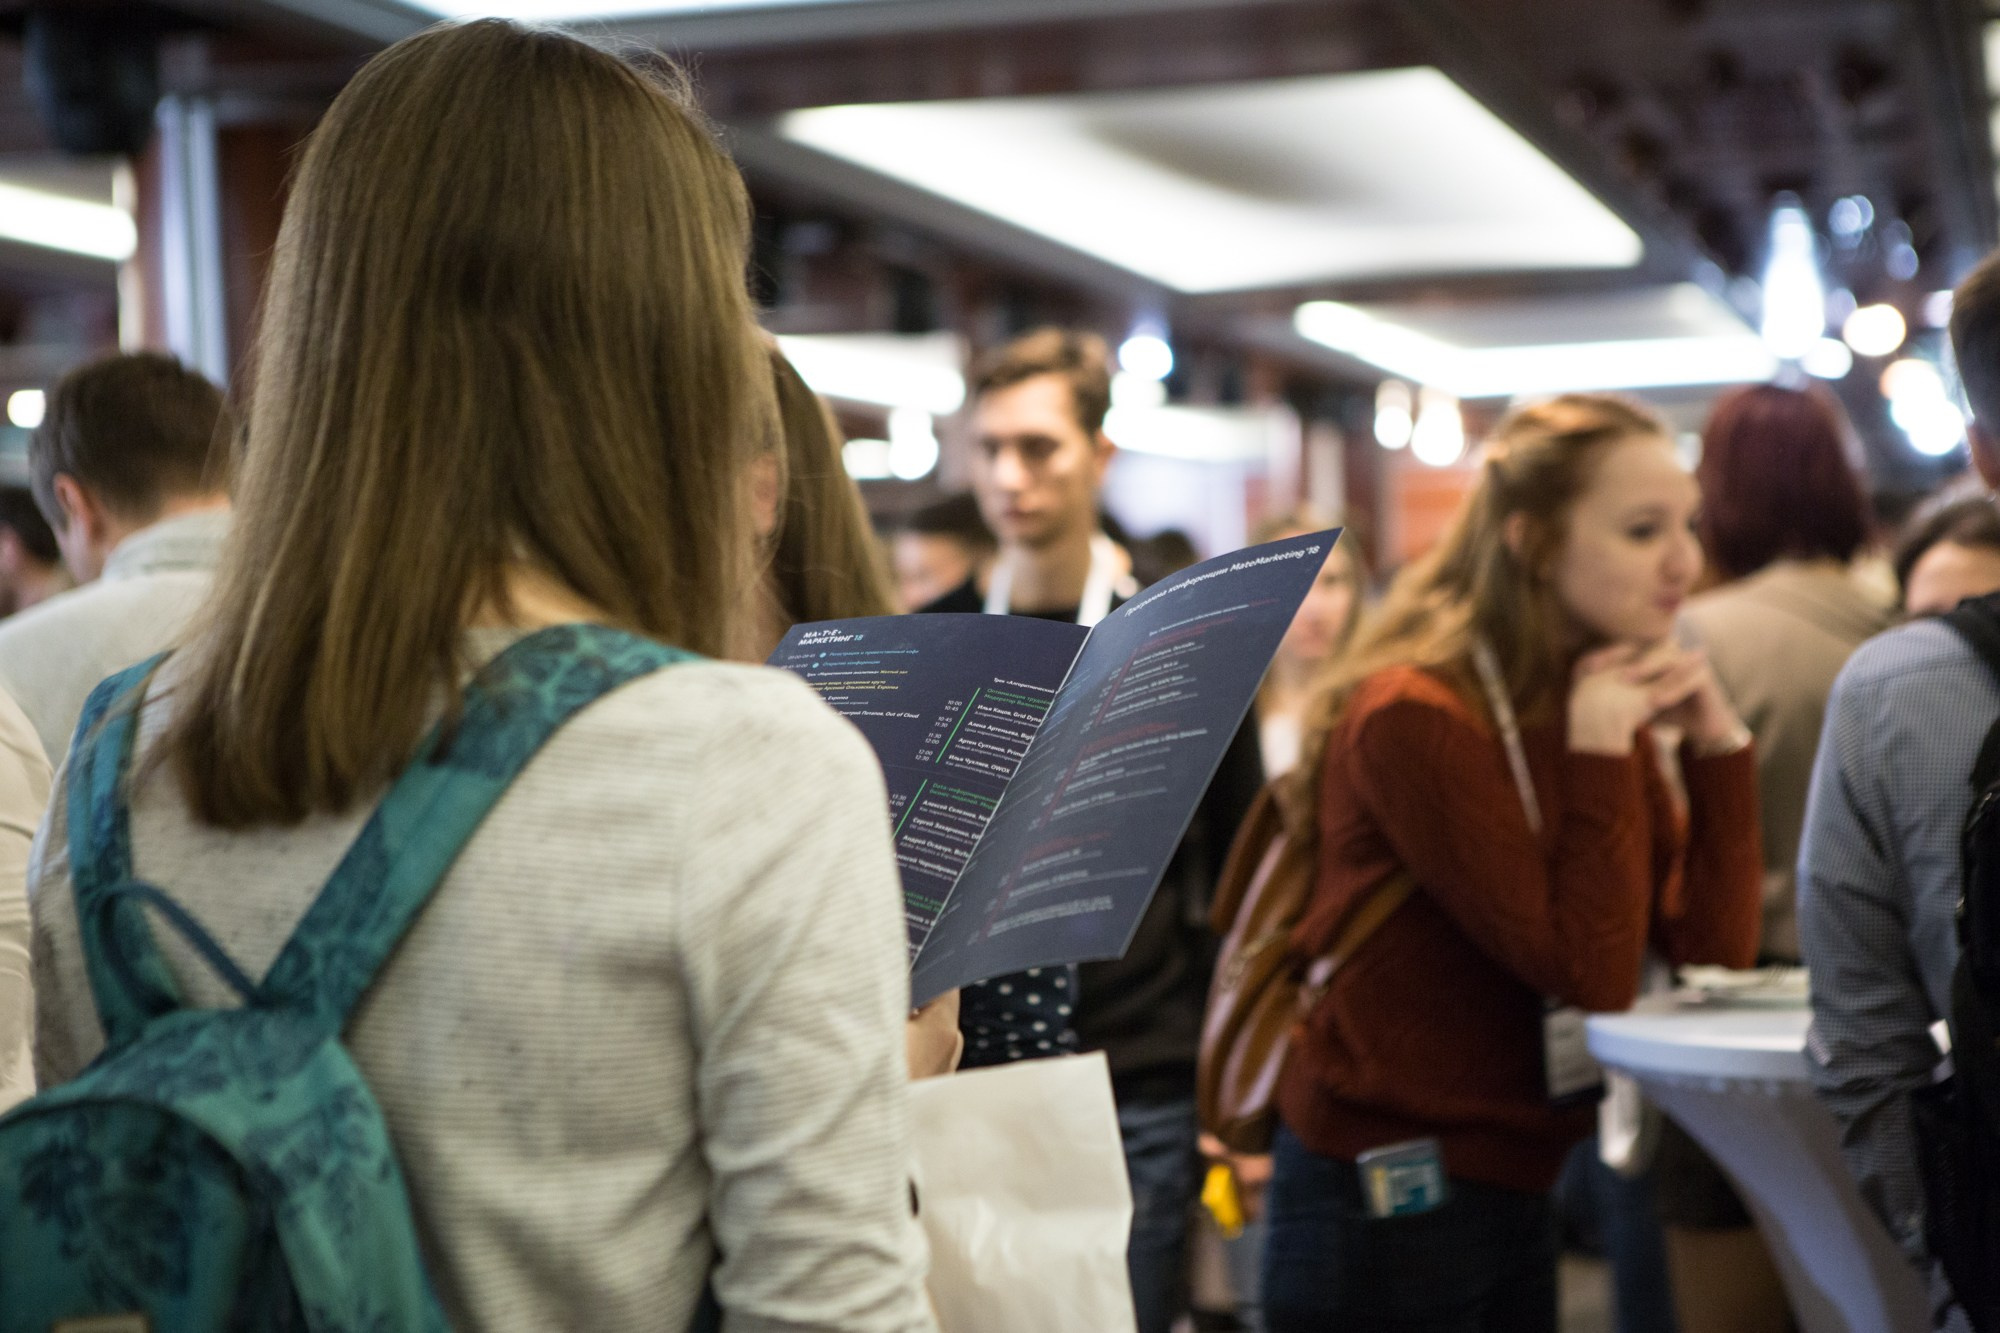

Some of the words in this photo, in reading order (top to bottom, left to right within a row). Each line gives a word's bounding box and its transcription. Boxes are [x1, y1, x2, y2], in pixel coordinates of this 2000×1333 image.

[1124, 590, 1167, 618] Программа
[1167, 566, 1228, 594] конференции
[1229, 548, 1306, 573] MateMarketing
[798, 635, 854, 646] МАРКЕТИНГ
[1012, 711, 1026, 719] Grid
[967, 721, 987, 729] Алена
[948, 754, 964, 762] Илья
[990, 764, 1011, 774] OWOX
